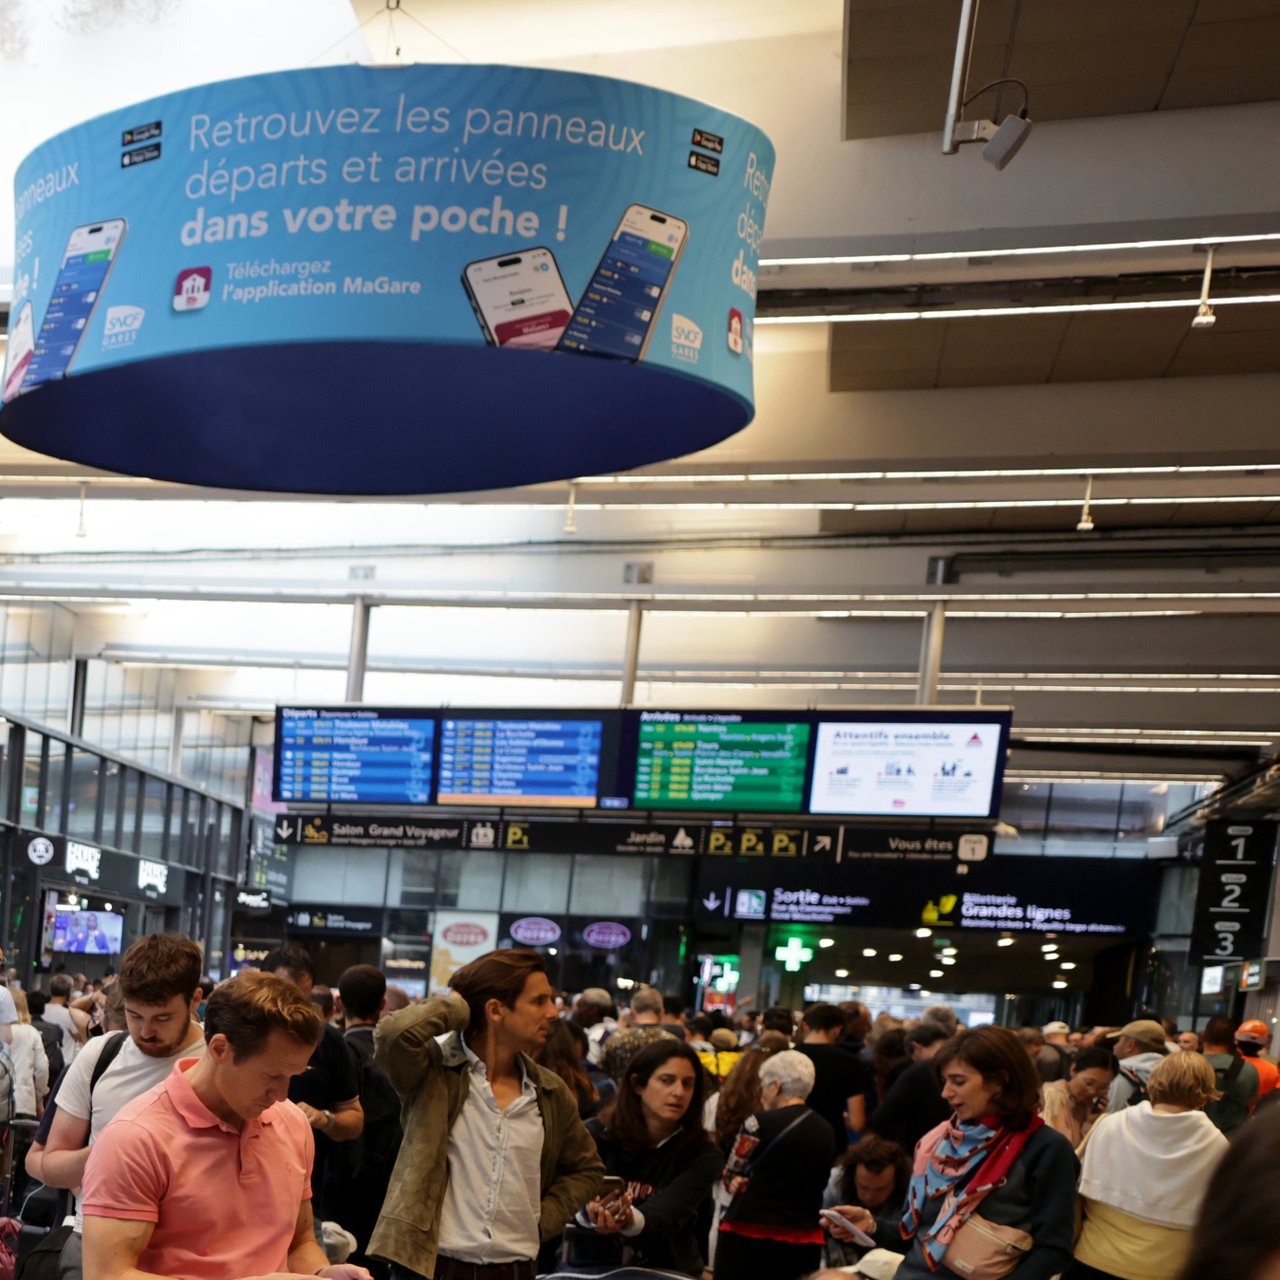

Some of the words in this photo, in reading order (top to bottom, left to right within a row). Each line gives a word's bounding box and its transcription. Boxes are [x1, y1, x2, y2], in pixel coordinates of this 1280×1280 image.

[188, 102, 379, 152] Retrouvez
[395, 95, 451, 134] les
[462, 102, 645, 157] panneaux
[184, 148, 328, 208] départs
[342, 153, 381, 183] et
[394, 148, 548, 191] arrivées
[179, 205, 269, 248] dans
[284, 200, 397, 235] votre
[410, 199, 541, 241] poche
[225, 256, 332, 280] Téléchargez
[342, 276, 422, 297] MaGare
[888, 837, 922, 851] Vous
[923, 837, 954, 851] êtes
[1230, 837, 1246, 861] 1
[1220, 883, 1242, 908] 2
[1214, 932, 1235, 956] 3
